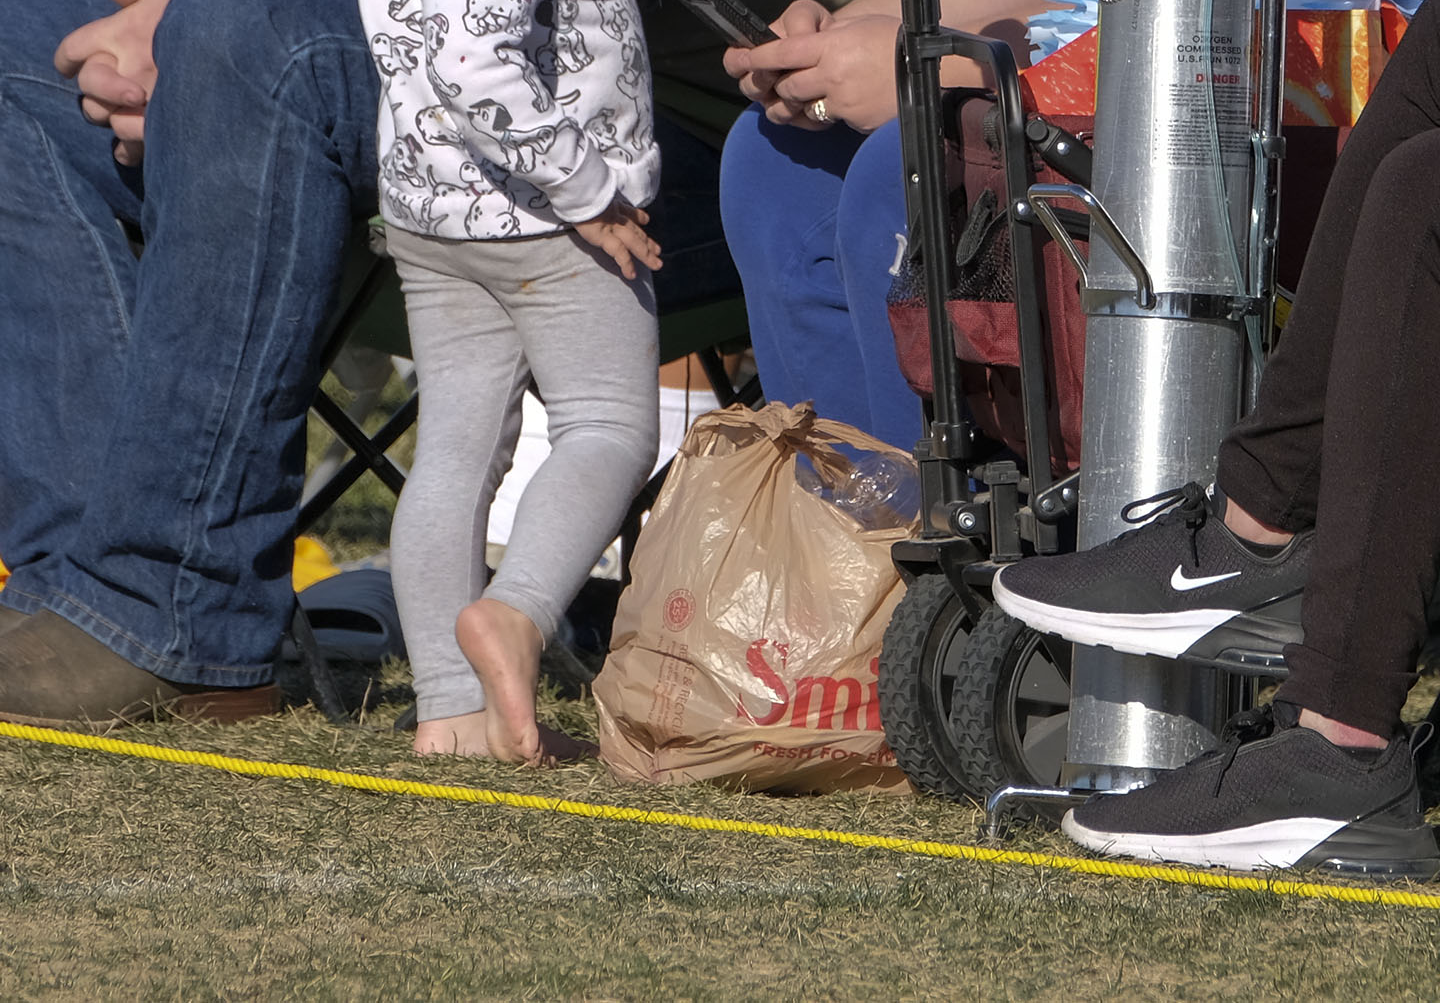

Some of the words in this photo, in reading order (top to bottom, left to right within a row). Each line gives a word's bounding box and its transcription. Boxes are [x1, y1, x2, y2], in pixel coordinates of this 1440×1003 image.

[1177, 45, 1242, 54] COMRESSED
[1225, 56, 1241, 65] 1072
[1196, 73, 1241, 84] DNGER
[753, 742, 814, 759] FRESH
